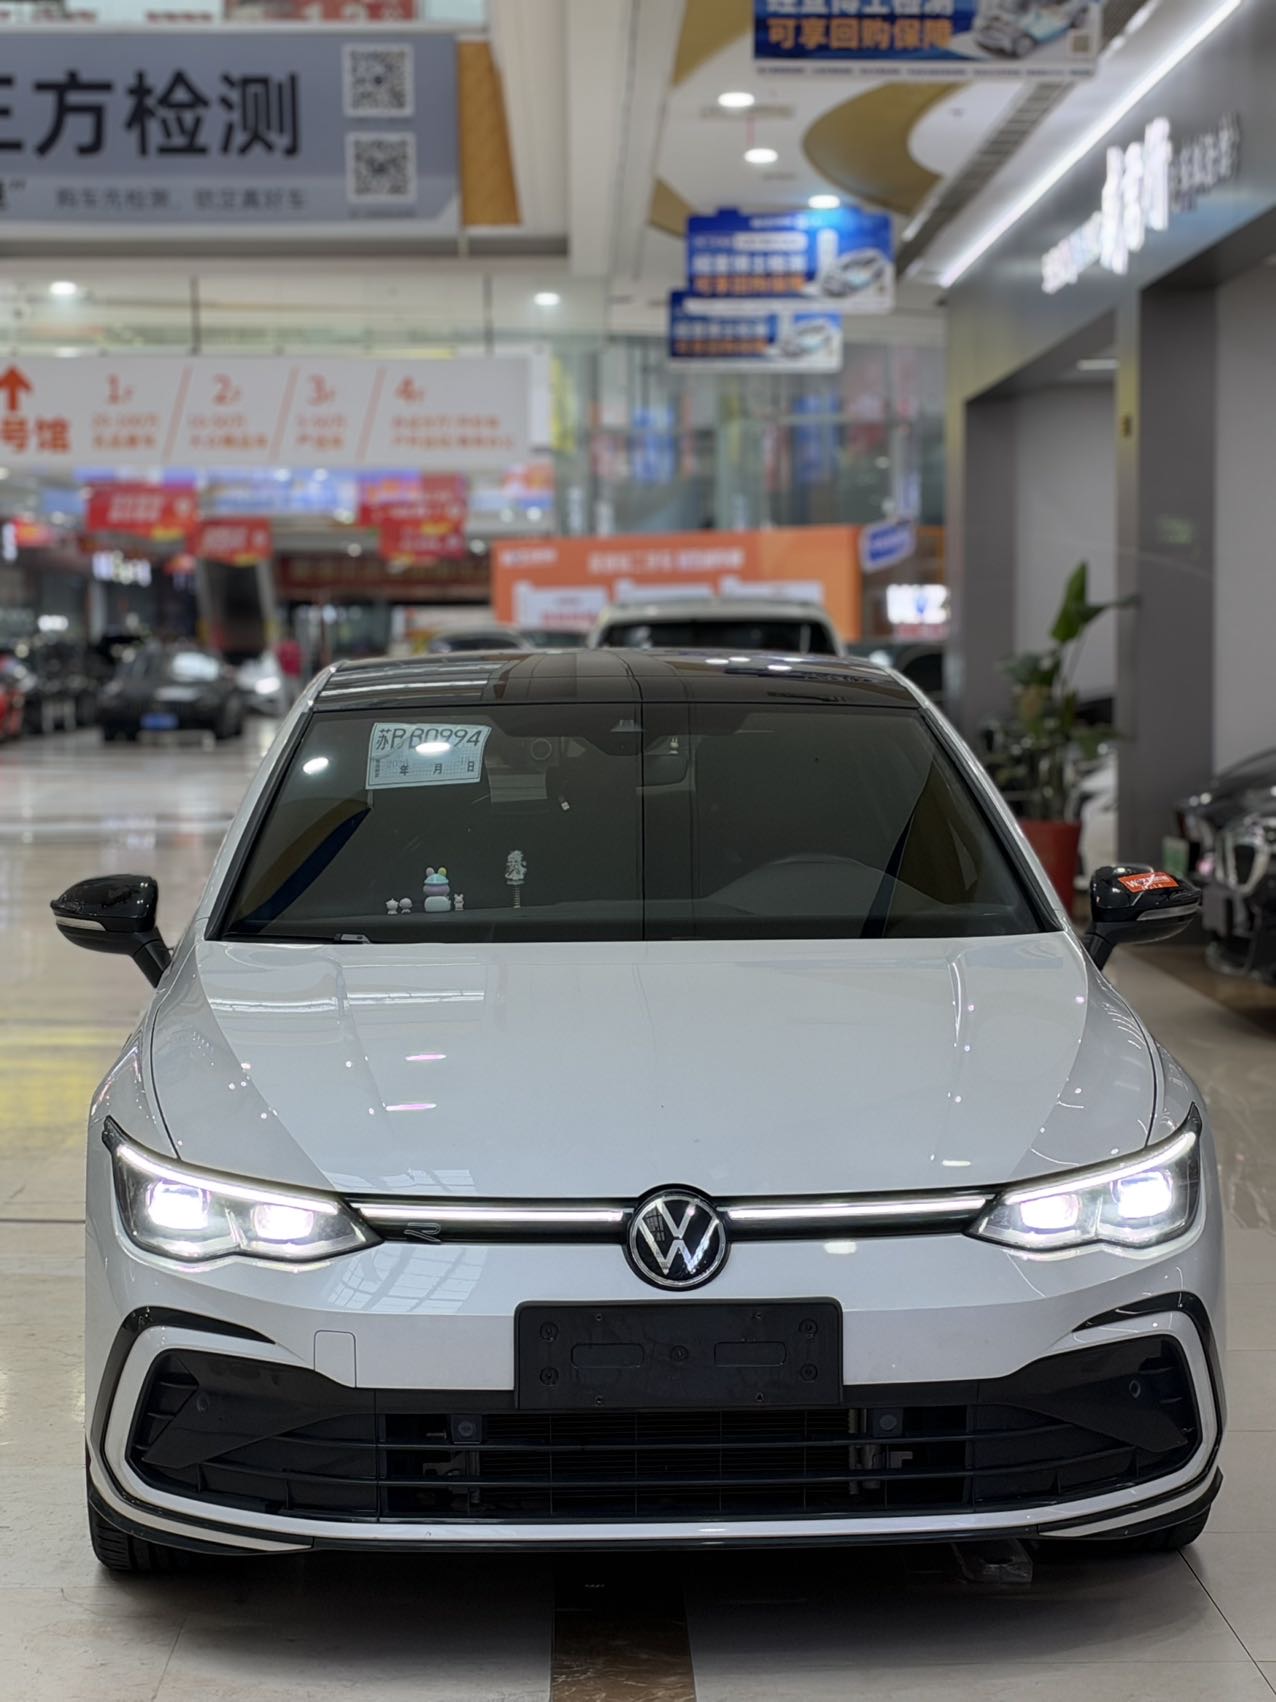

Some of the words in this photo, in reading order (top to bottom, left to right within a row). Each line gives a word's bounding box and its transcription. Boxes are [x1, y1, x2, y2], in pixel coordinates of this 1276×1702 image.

[767, 18, 954, 49] 可享回购保障
[433, 763, 443, 775] 月
[467, 761, 475, 773] 日
